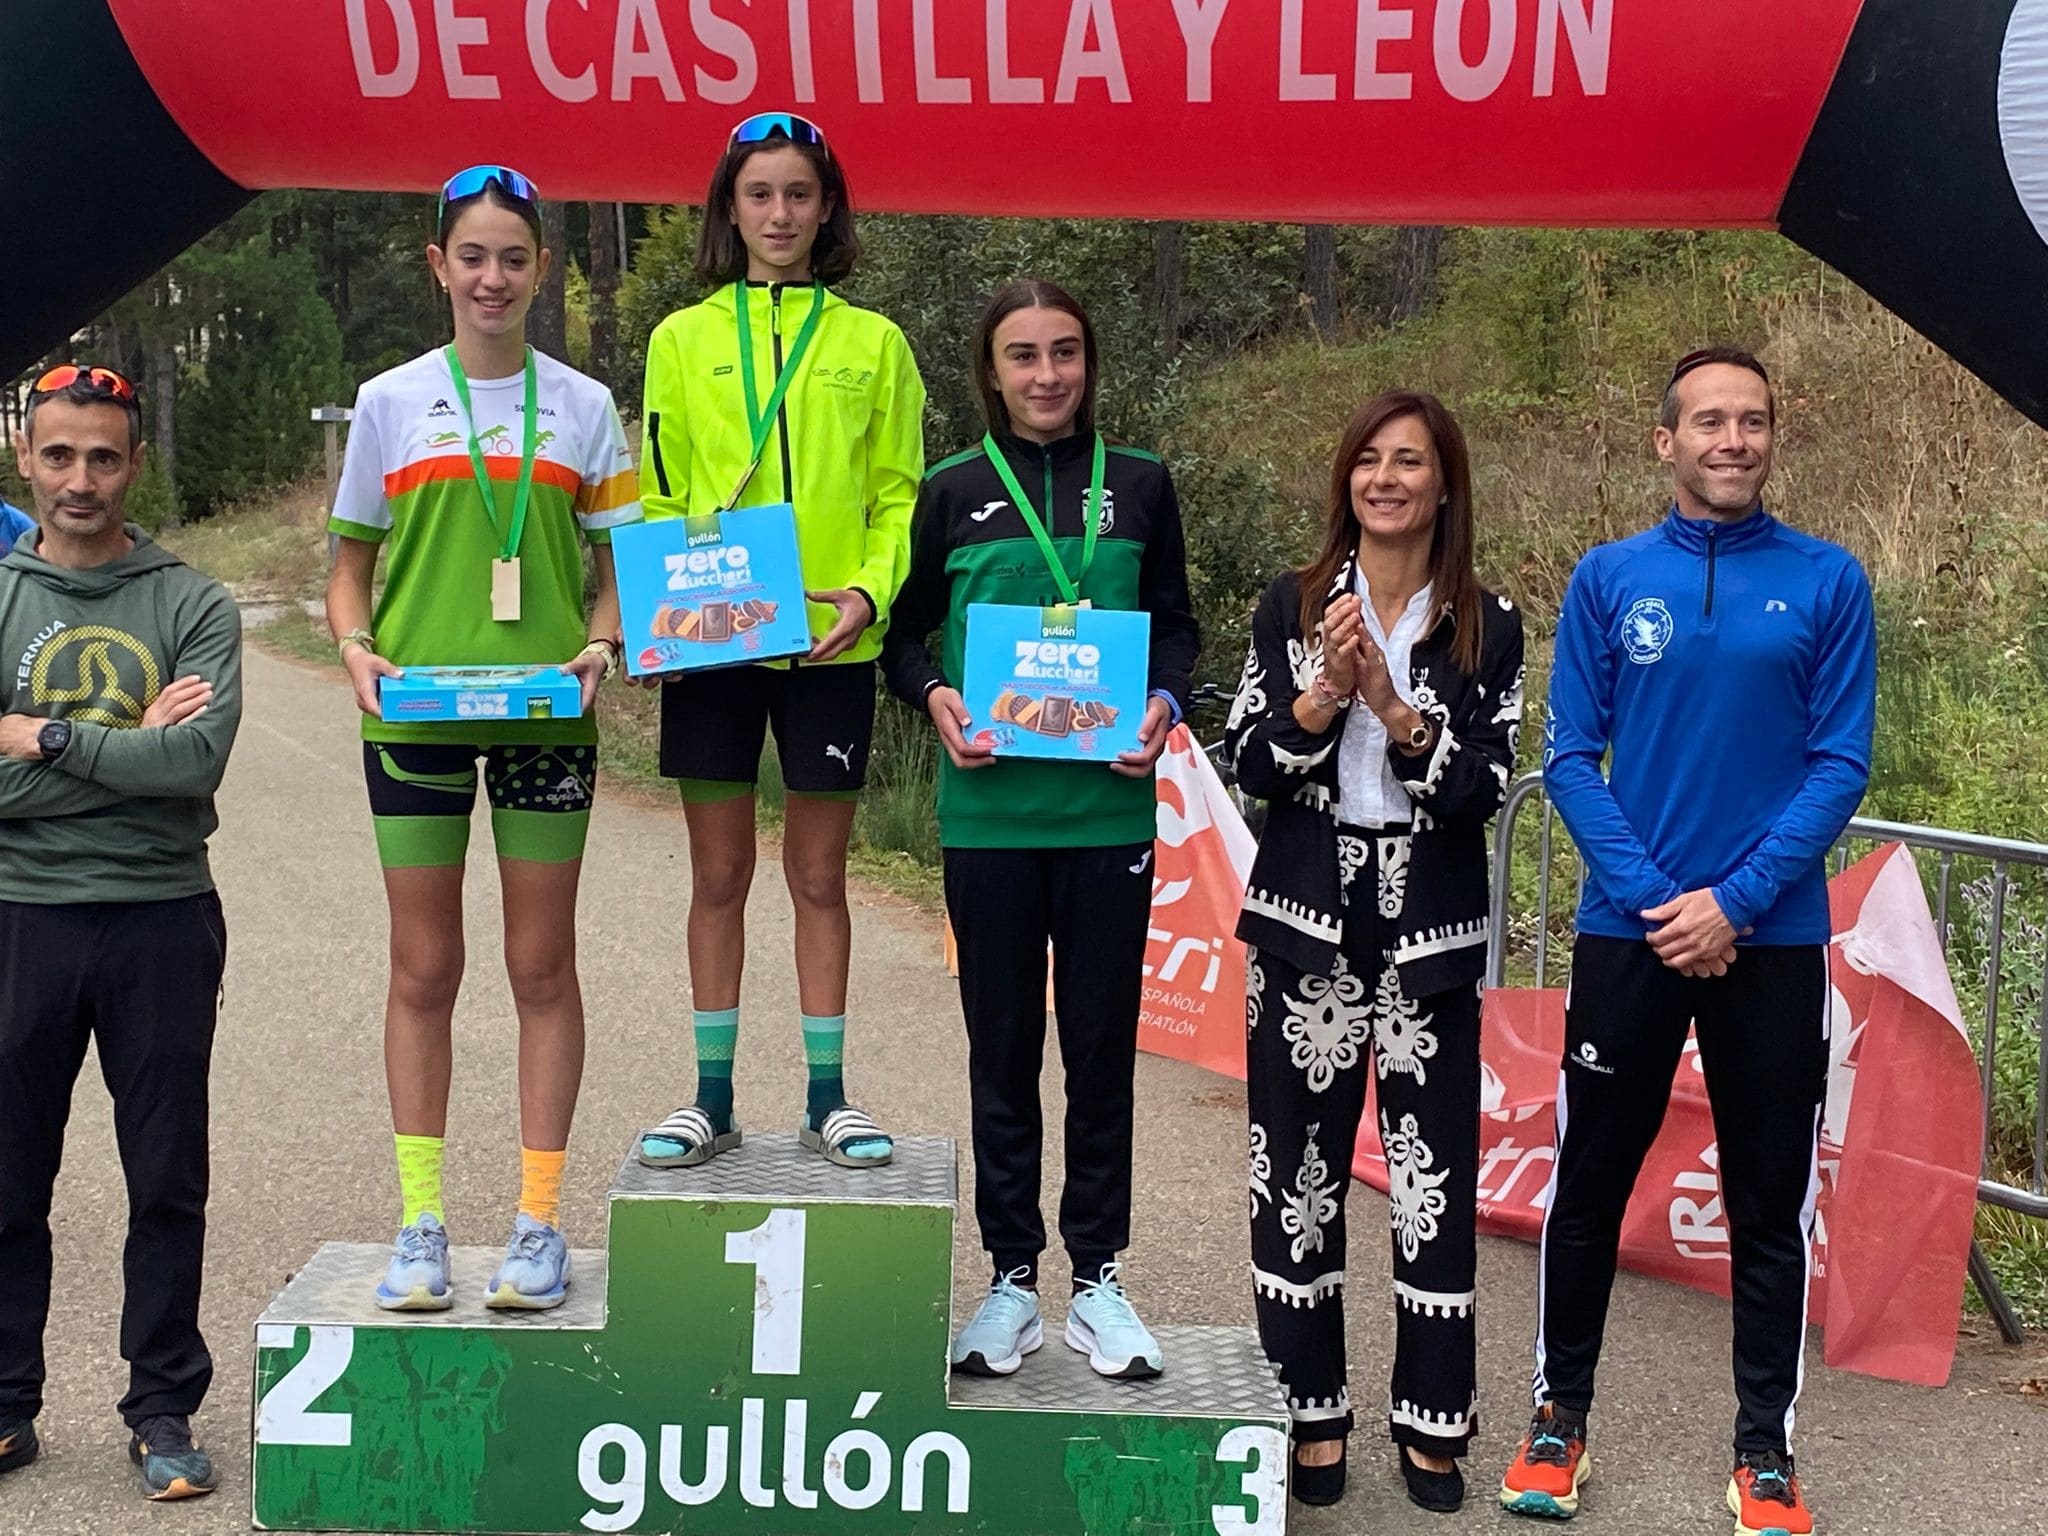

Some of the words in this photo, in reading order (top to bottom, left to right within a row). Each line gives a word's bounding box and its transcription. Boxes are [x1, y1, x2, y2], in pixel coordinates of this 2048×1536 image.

[343, 0, 501, 99] DE
[525, 0, 1132, 104] CASTILLA
[1172, 0, 1227, 103] Y
[687, 532, 721, 547] gullón
[17, 619, 67, 691] TERNUA
[1042, 625, 1075, 637] gullón
[1138, 1009, 1198, 1038] RIATLÓN
[1141, 985, 1206, 1015] SPAÑOLA
[724, 1208, 807, 1376] 1
[257, 1324, 355, 1447] 2
[577, 1391, 971, 1533] gullón
[1211, 1425, 1287, 1536] 3
